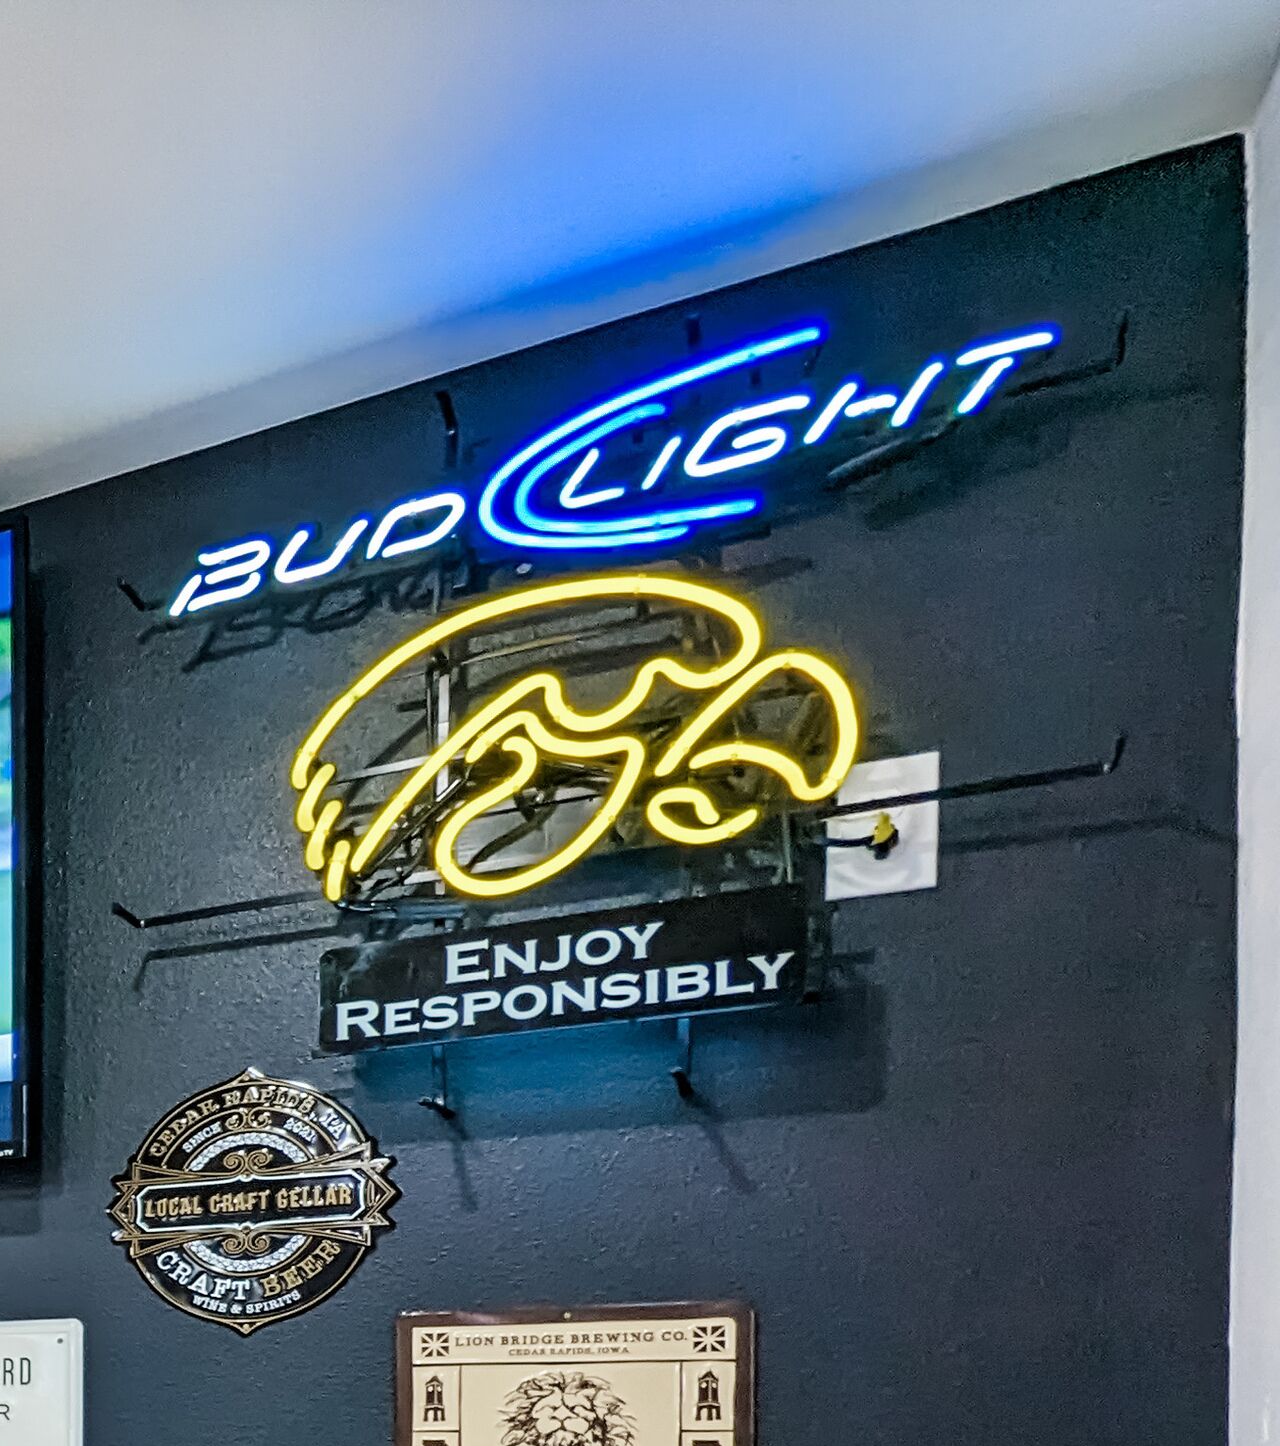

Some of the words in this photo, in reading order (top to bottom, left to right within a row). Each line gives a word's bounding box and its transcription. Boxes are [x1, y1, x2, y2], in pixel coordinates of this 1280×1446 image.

[169, 490, 466, 617] BUD
[559, 331, 1056, 510] LIGHT
[444, 920, 666, 985] ENJOY
[334, 951, 796, 1042] RESPONSIBLY
[182, 1121, 222, 1154] SINCE
[144, 1197, 204, 1219] LOCAL
[208, 1190, 269, 1214] CRAFT
[156, 1250, 251, 1301] CRAFT
[259, 1239, 340, 1298] BEER
[192, 1294, 228, 1314] WINE
[246, 1289, 301, 1314] SPIRITS
[455, 1336, 494, 1347] LION
[500, 1334, 565, 1346] BRIDGE
[570, 1332, 655, 1344] BREWING
[661, 1331, 688, 1341] CO.
[508, 1348, 545, 1356] CEDAR
[597, 1346, 630, 1354] IOWA
